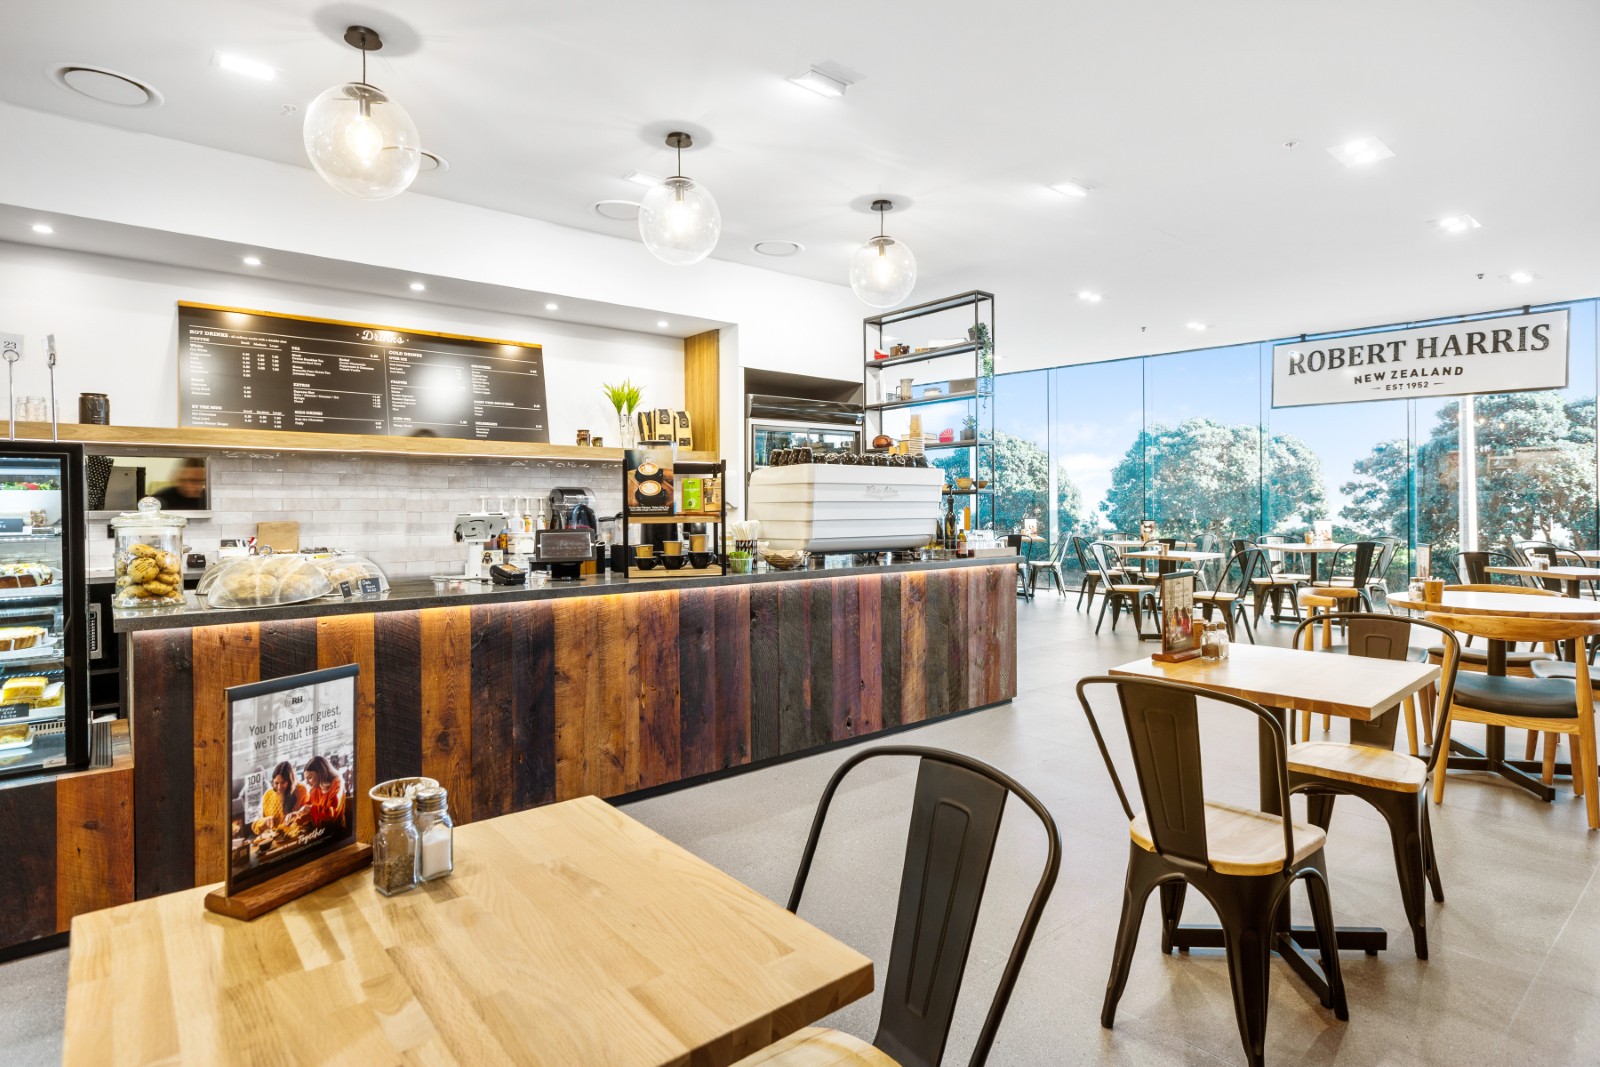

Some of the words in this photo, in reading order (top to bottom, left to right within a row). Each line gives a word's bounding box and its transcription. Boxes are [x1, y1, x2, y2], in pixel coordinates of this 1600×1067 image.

[4, 341, 16, 349] 23
[361, 330, 404, 344] Drinks
[1288, 340, 1406, 376] ROBERT
[1416, 324, 1550, 360] HARRIS
[1354, 372, 1386, 384] NEW
[1390, 367, 1464, 380] ZEALAND
[292, 696, 303, 704] RH
[249, 725, 266, 737] You
[269, 719, 292, 732] bring
[296, 713, 314, 727] your
[254, 734, 275, 750] we'll
[278, 729, 302, 743] shout
[306, 724, 318, 737] the
[321, 719, 340, 732] rest.
[248, 774, 260, 786] 100
[298, 827, 325, 844] Together
